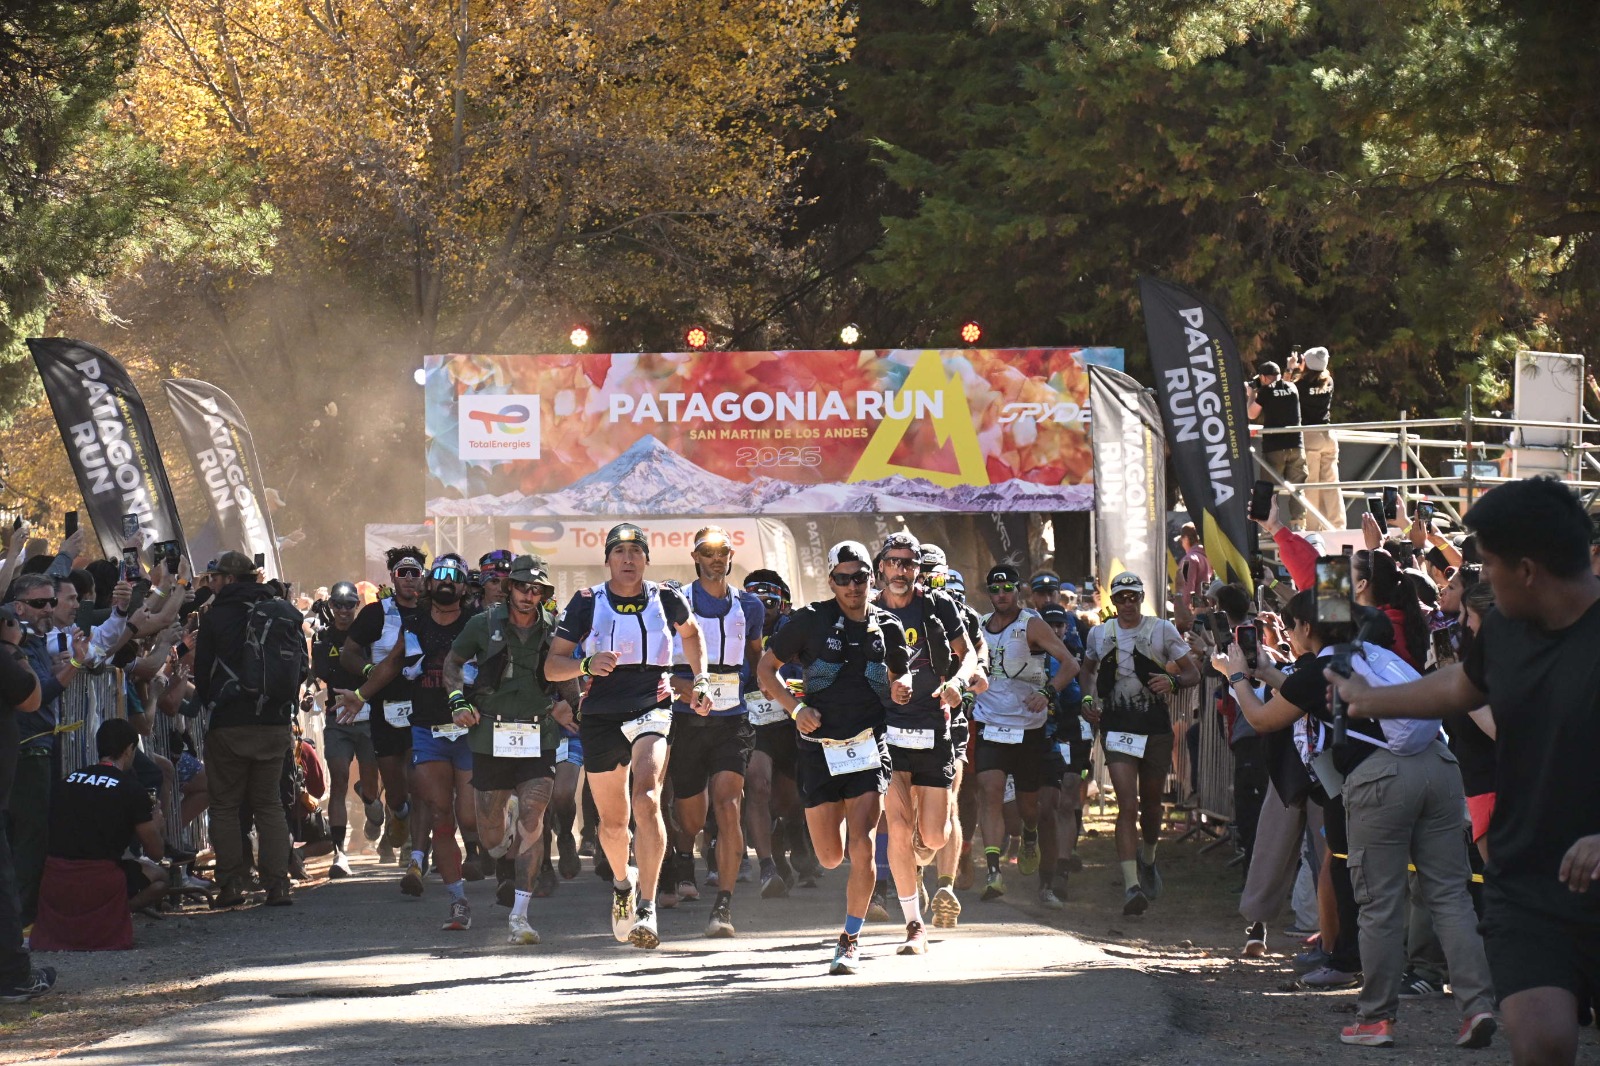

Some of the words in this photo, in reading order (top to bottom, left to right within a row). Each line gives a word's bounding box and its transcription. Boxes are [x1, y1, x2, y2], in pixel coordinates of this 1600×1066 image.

[1213, 338, 1223, 356] SAN
[1218, 358, 1229, 393] MARTIN
[609, 390, 850, 423] PATAGONIA
[856, 390, 943, 419] RUN
[998, 400, 1092, 423] SPYDE
[1164, 367, 1200, 443] RUN
[1178, 306, 1235, 507] PATAGONIA
[1224, 395, 1232, 407] DE
[1226, 409, 1235, 427] LOS
[689, 429, 716, 440] SAN
[720, 428, 771, 440] MARTIN
[774, 428, 793, 439] DE
[797, 428, 820, 439] LOS
[824, 427, 869, 438] ANDES
[1229, 428, 1239, 459] ANDES
[75, 358, 159, 551] PATAGONIA
[468, 439, 531, 450] TotalEnergies
[69, 420, 115, 495] RUN
[138, 453, 149, 471] LOS
[735, 446, 822, 467] 2026
[196, 448, 236, 511] RUN
[198, 396, 266, 552] PATAGONIA
[1099, 441, 1123, 513] RUN
[1119, 392, 1148, 560] PATAGONIA
[397, 707, 411, 717] 27
[757, 703, 773, 714] 32
[509, 735, 524, 746] 31
[1119, 735, 1134, 745] 20
[846, 748, 856, 759] 6
[66, 772, 120, 788] STAFF
